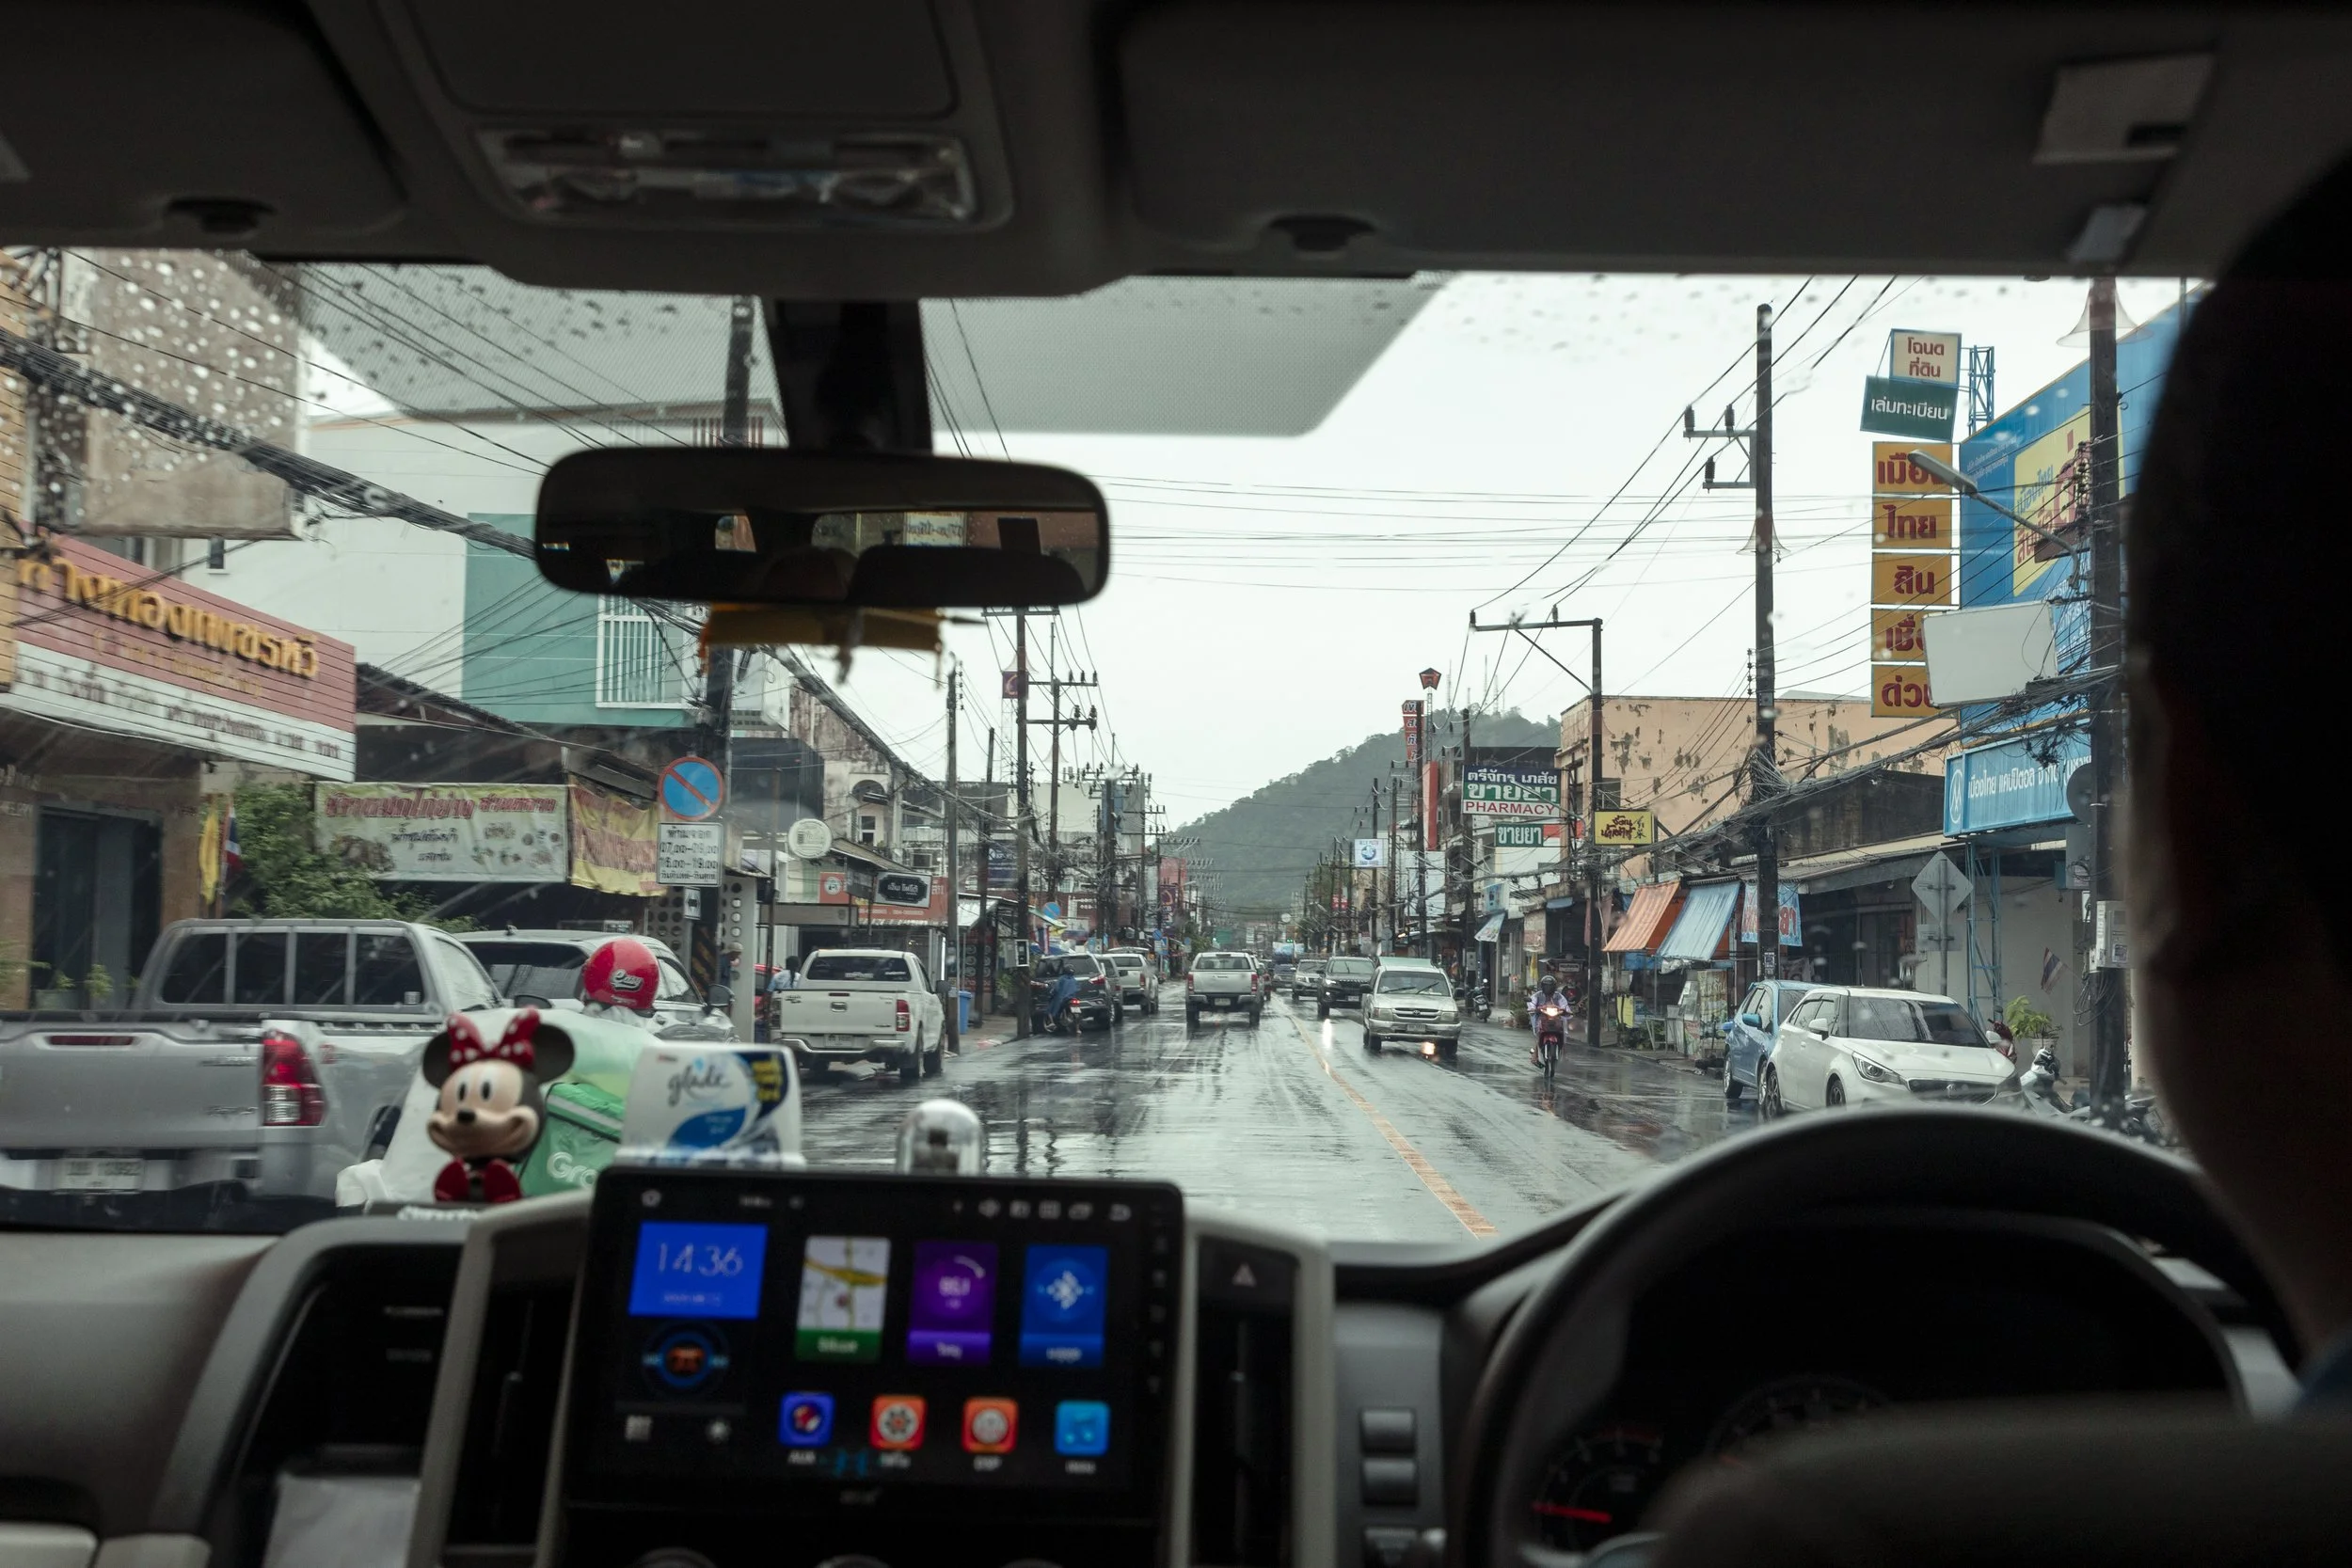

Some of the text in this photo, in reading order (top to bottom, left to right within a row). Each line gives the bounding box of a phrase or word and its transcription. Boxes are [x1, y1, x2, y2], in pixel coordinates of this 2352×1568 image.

[1907, 337, 1945, 356] โฉนด
[1909, 356, 1941, 377] ที่ดิน
[1870, 396, 1947, 420] เล่มทะเบียน
[1878, 452, 1944, 485] เมือ
[1882, 504, 1936, 539] ไทย
[1894, 565, 1934, 594] สิน
[1882, 674, 1930, 708] ด่ว
[1521, 771, 1558, 784] เภสัช
[1468, 784, 1558, 802] ขายยา
[1465, 801, 1555, 816] PHARMACY
[1498, 827, 1542, 845] ขายยา
[668, 1064, 731, 1107] glade
[548, 1151, 598, 1189] Gra
